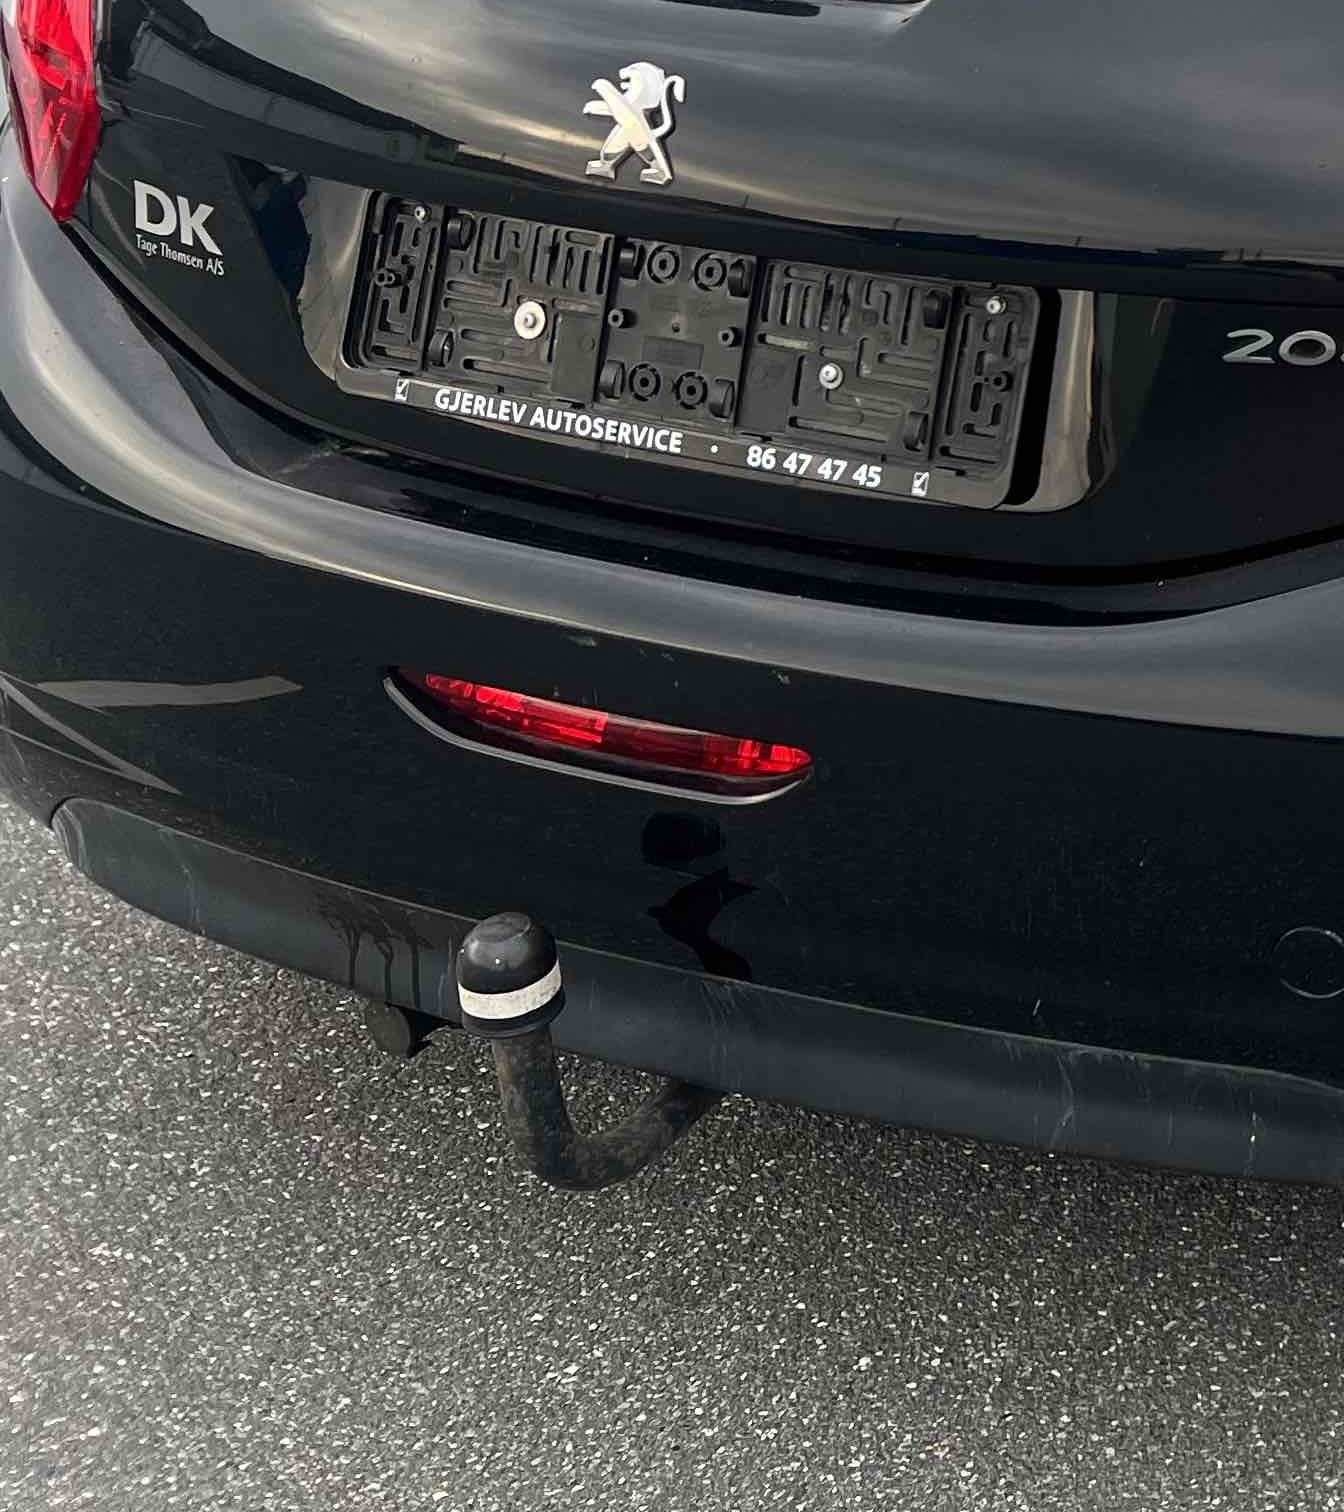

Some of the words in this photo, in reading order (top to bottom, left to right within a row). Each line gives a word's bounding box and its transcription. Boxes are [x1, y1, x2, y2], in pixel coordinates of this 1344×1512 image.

[134, 179, 223, 256] DK
[136, 234, 158, 256] Tage
[160, 242, 203, 269] Thomsen
[206, 257, 224, 275] A/S
[434, 388, 527, 423] GJERLEV
[529, 406, 683, 453] AUTOSERVICE
[746, 445, 777, 470] 86
[782, 452, 813, 475] 47
[817, 458, 848, 481] 47
[852, 464, 882, 488] 45
